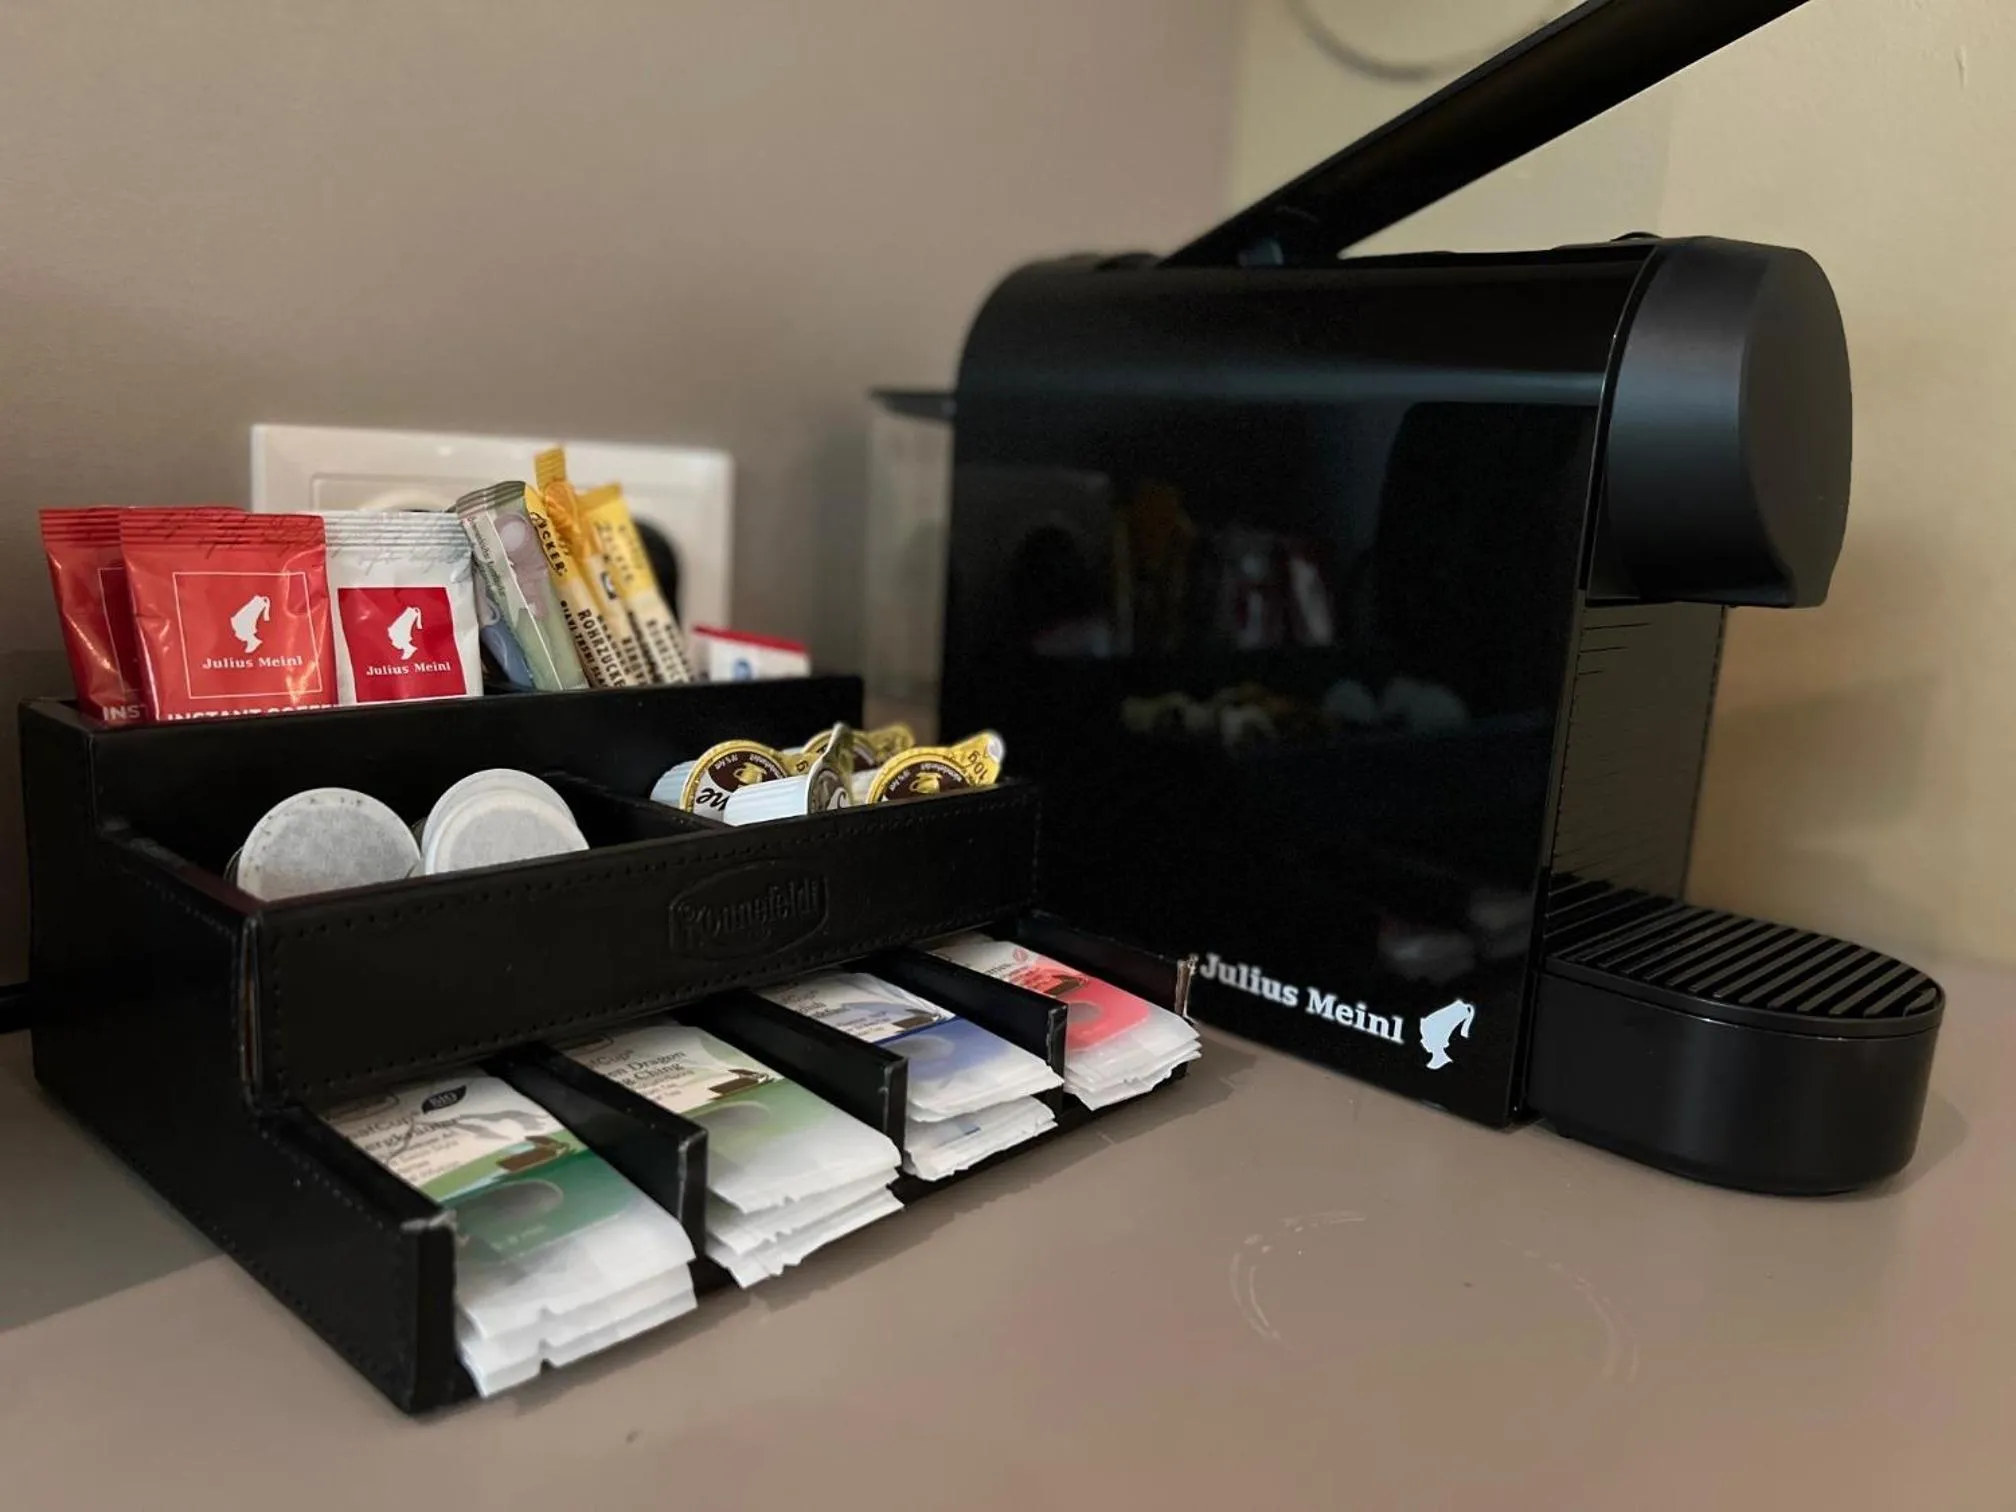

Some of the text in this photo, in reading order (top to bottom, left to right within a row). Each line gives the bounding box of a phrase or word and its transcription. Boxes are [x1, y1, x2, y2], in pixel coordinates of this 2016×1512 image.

[577, 608, 626, 688] ROHRZUCKE
[202, 655, 303, 670] Julius Meinl
[366, 661, 451, 676] Julius Meinl
[695, 787, 731, 812] ne
[1200, 952, 1405, 1045] Julius Meinl
